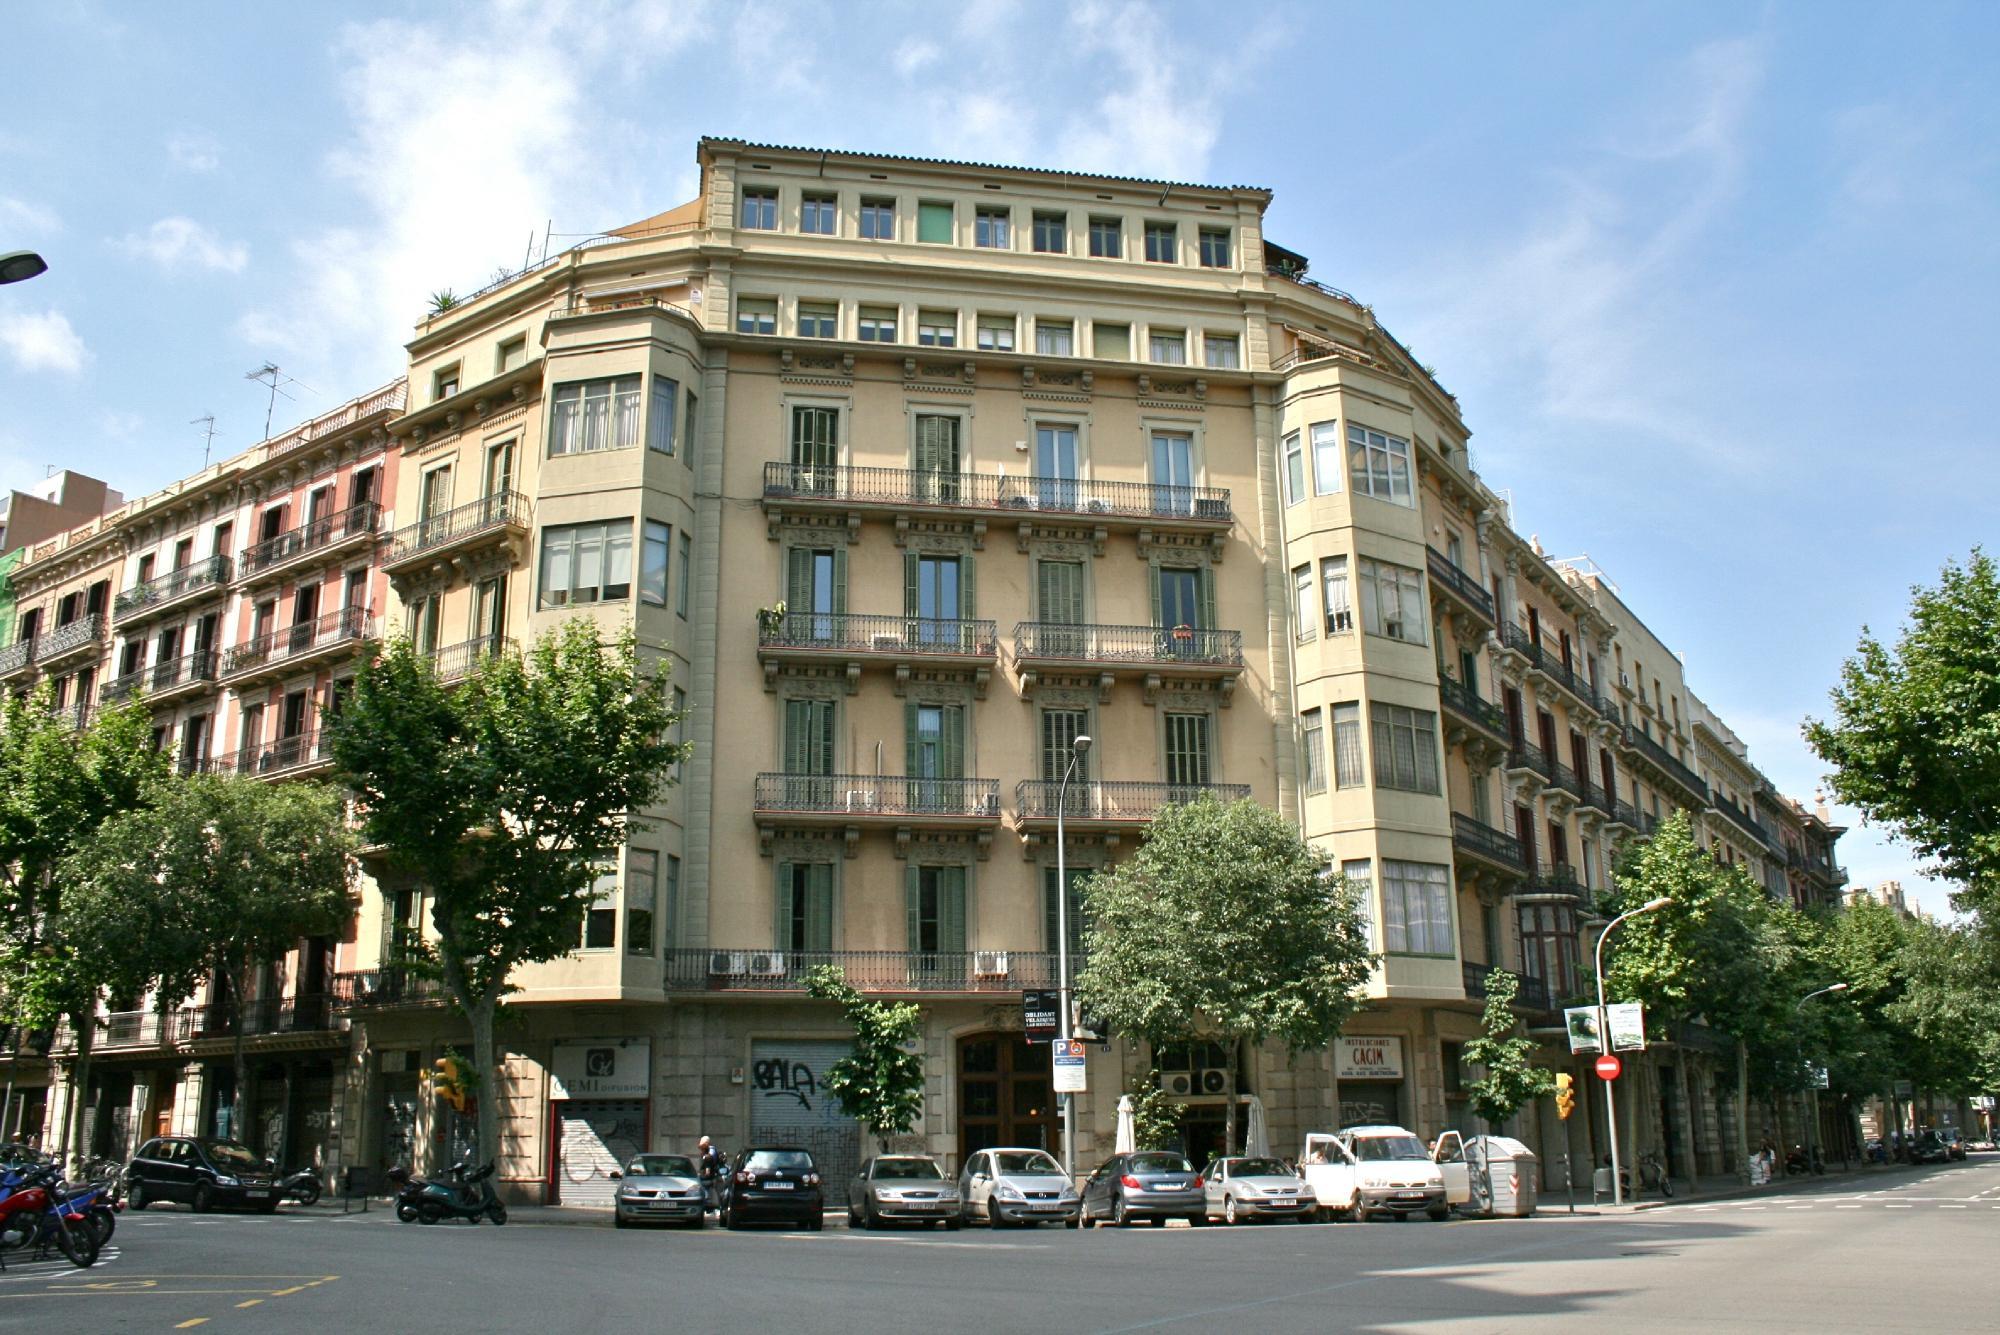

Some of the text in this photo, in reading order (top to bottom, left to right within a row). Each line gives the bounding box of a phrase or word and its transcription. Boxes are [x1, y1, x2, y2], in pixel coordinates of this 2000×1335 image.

[1057, 1042, 1067, 1055] P
[1353, 1047, 1384, 1066] CACIM
[554, 1079, 599, 1093] GEMI
